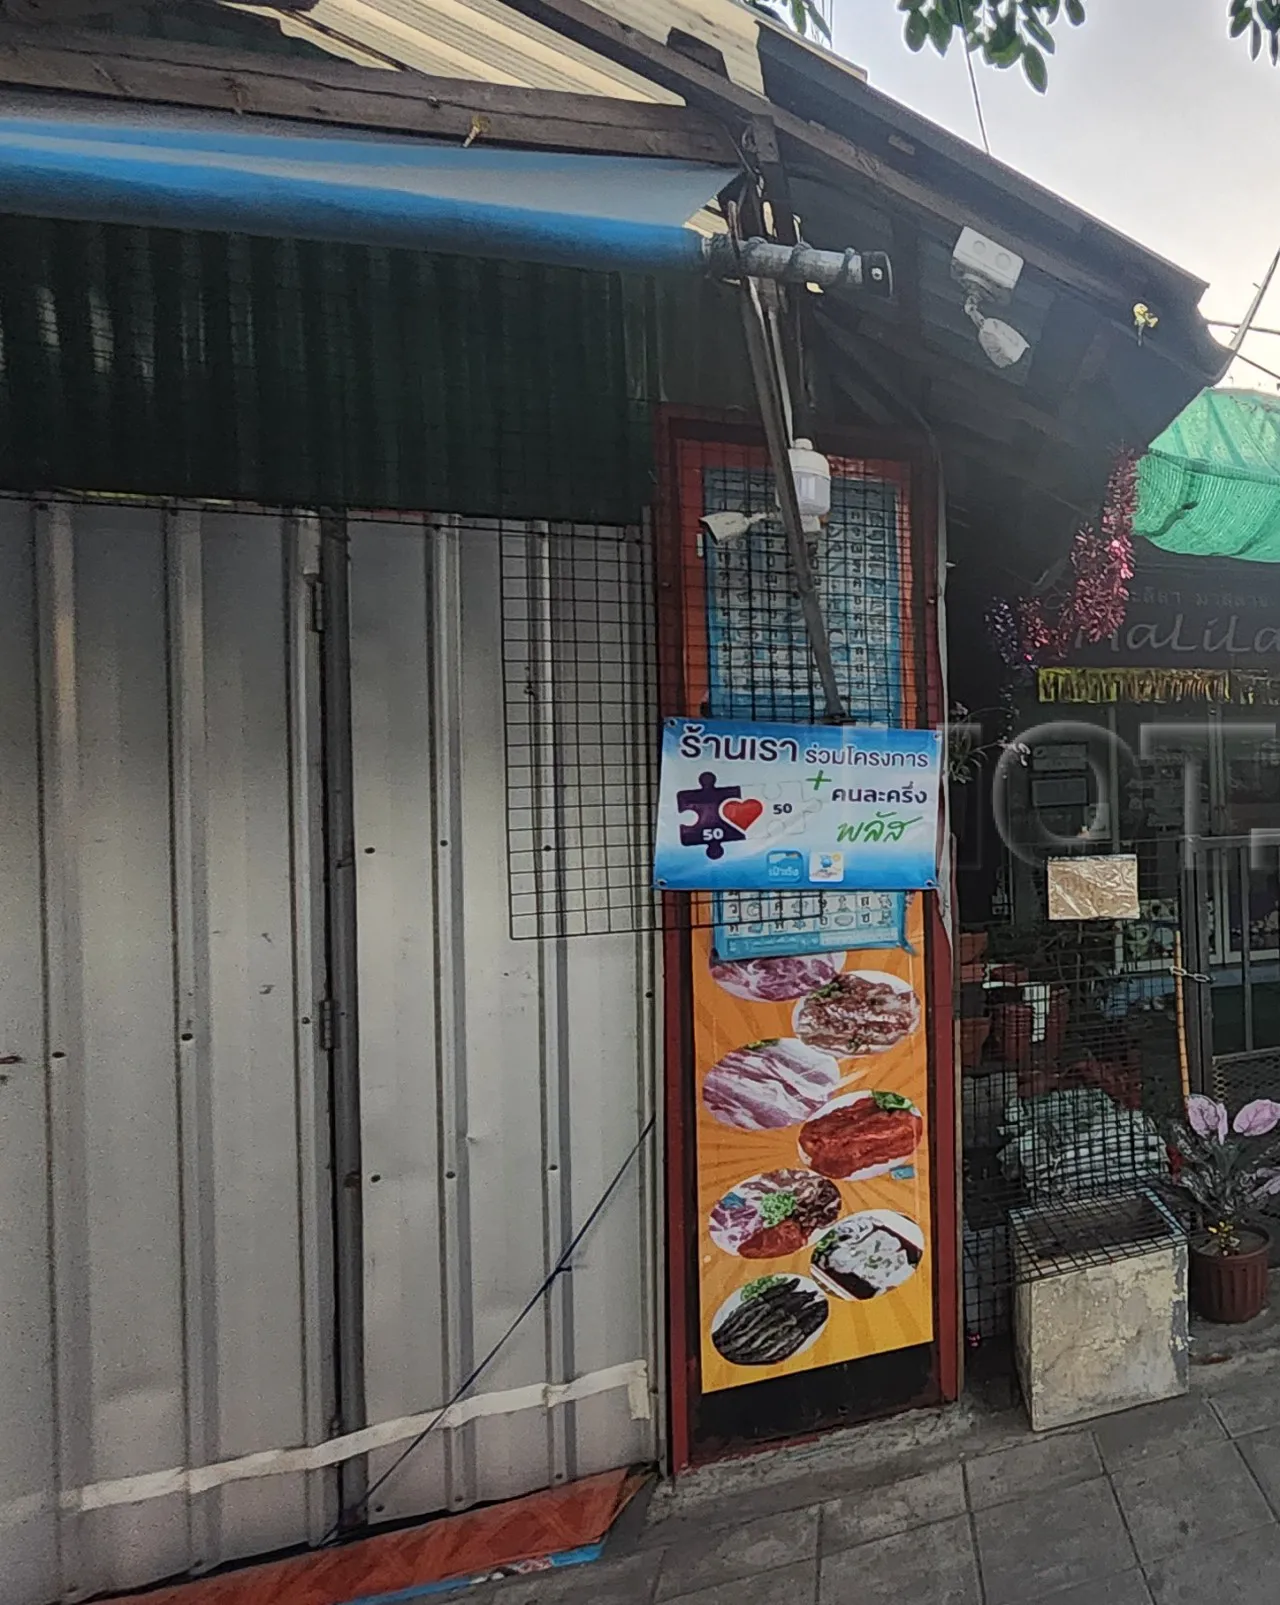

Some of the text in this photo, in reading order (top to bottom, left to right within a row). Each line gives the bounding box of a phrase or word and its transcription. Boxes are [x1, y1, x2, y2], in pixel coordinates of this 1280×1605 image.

[681, 724, 928, 768] ร้านเรา ร่วมโครงการ
[831, 781, 928, 804] คนละครึ่ง
[772, 803, 793, 814] 50
[702, 828, 724, 841] 50
[836, 811, 924, 843] พลัส
